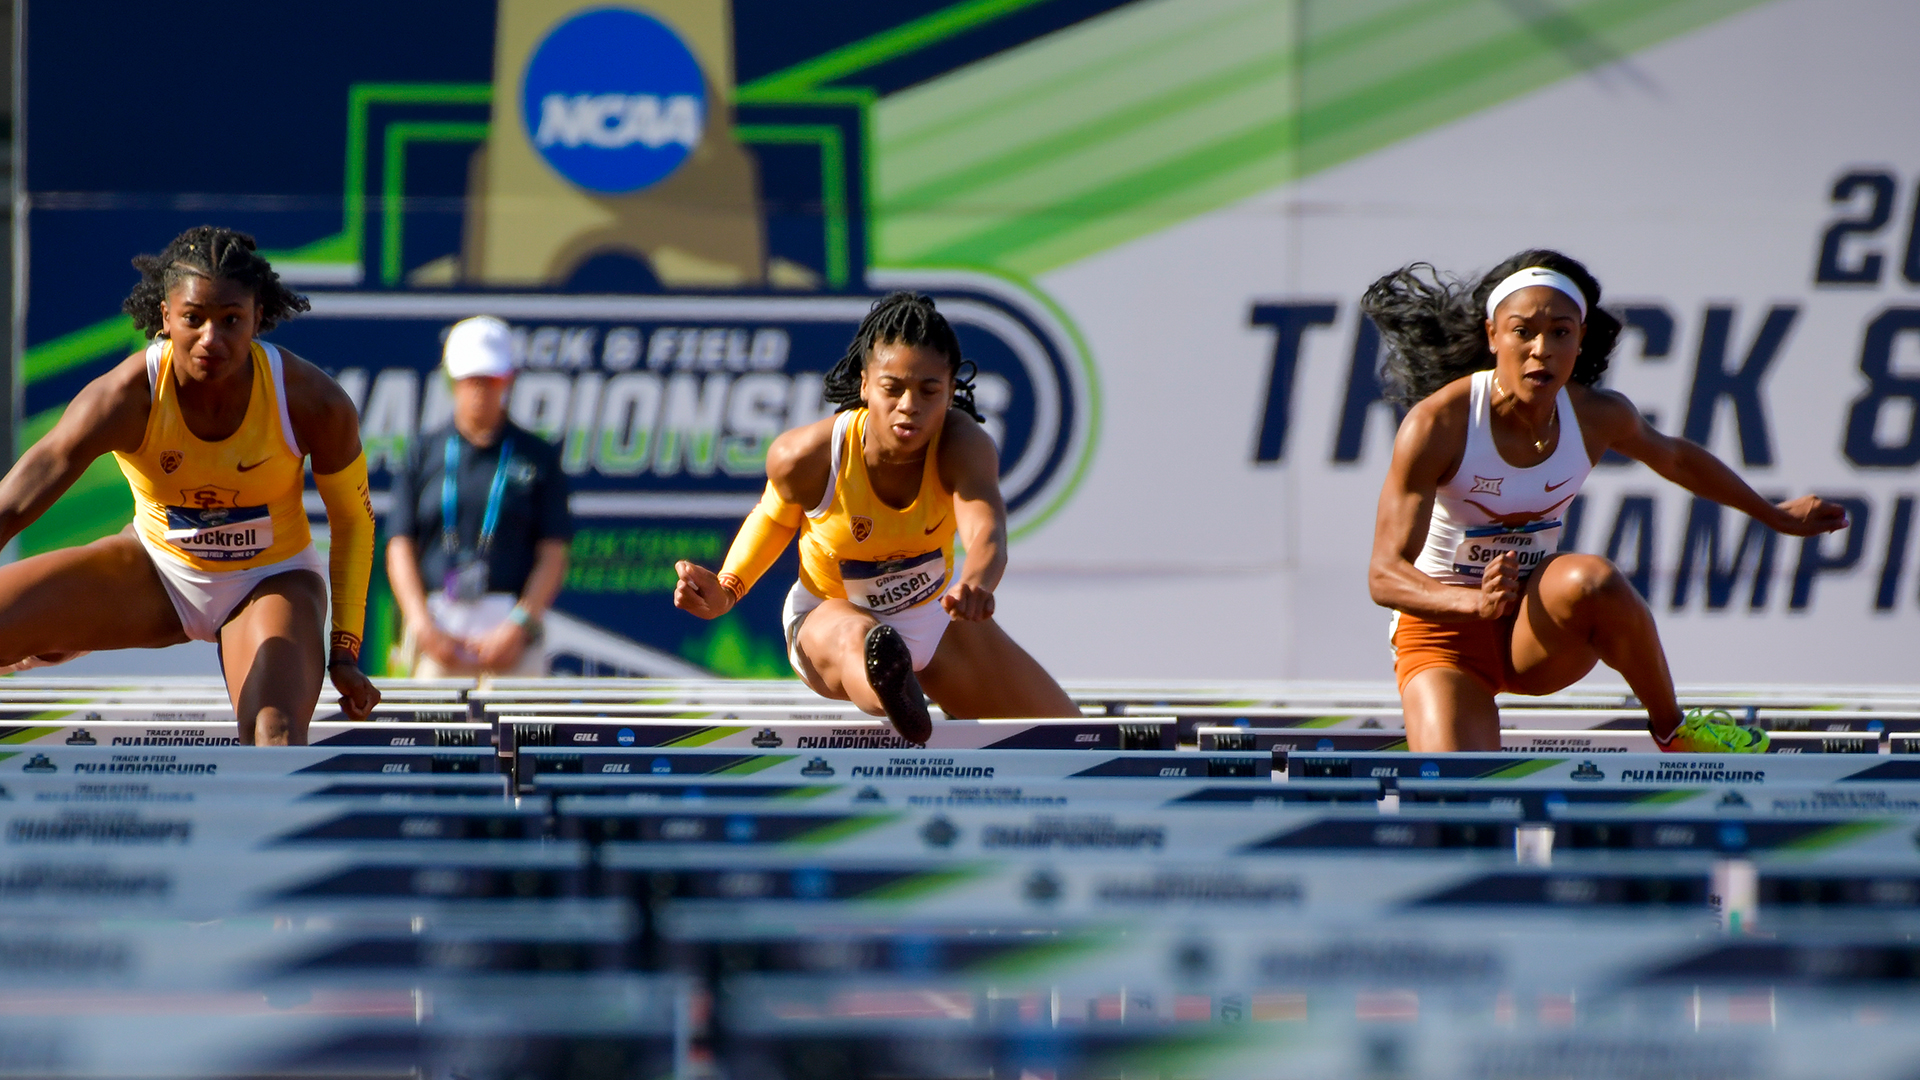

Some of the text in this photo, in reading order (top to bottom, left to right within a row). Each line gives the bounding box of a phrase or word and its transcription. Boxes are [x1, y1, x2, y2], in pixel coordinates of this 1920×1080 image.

[535, 93, 699, 149] NCAA
[1815, 172, 1920, 284] 2
[647, 327, 790, 371] FIELD
[1468, 545, 1547, 565] Seyour
[145, 729, 174, 737] TRACK
[181, 729, 205, 737] FIELD
[572, 733, 599, 742] GILL
[1074, 733, 1101, 742] GILL
[389, 737, 416, 746] GILL
[1532, 738, 1558, 746] TRACK
[1271, 743, 1298, 752] GILL
[381, 763, 411, 773] GILL
[601, 763, 631, 773] GILL
[1659, 761, 1687, 769] TRACK
[1698, 761, 1724, 769] FIELD
[1159, 767, 1188, 777] GILL
[1370, 767, 1399, 777] GILL
